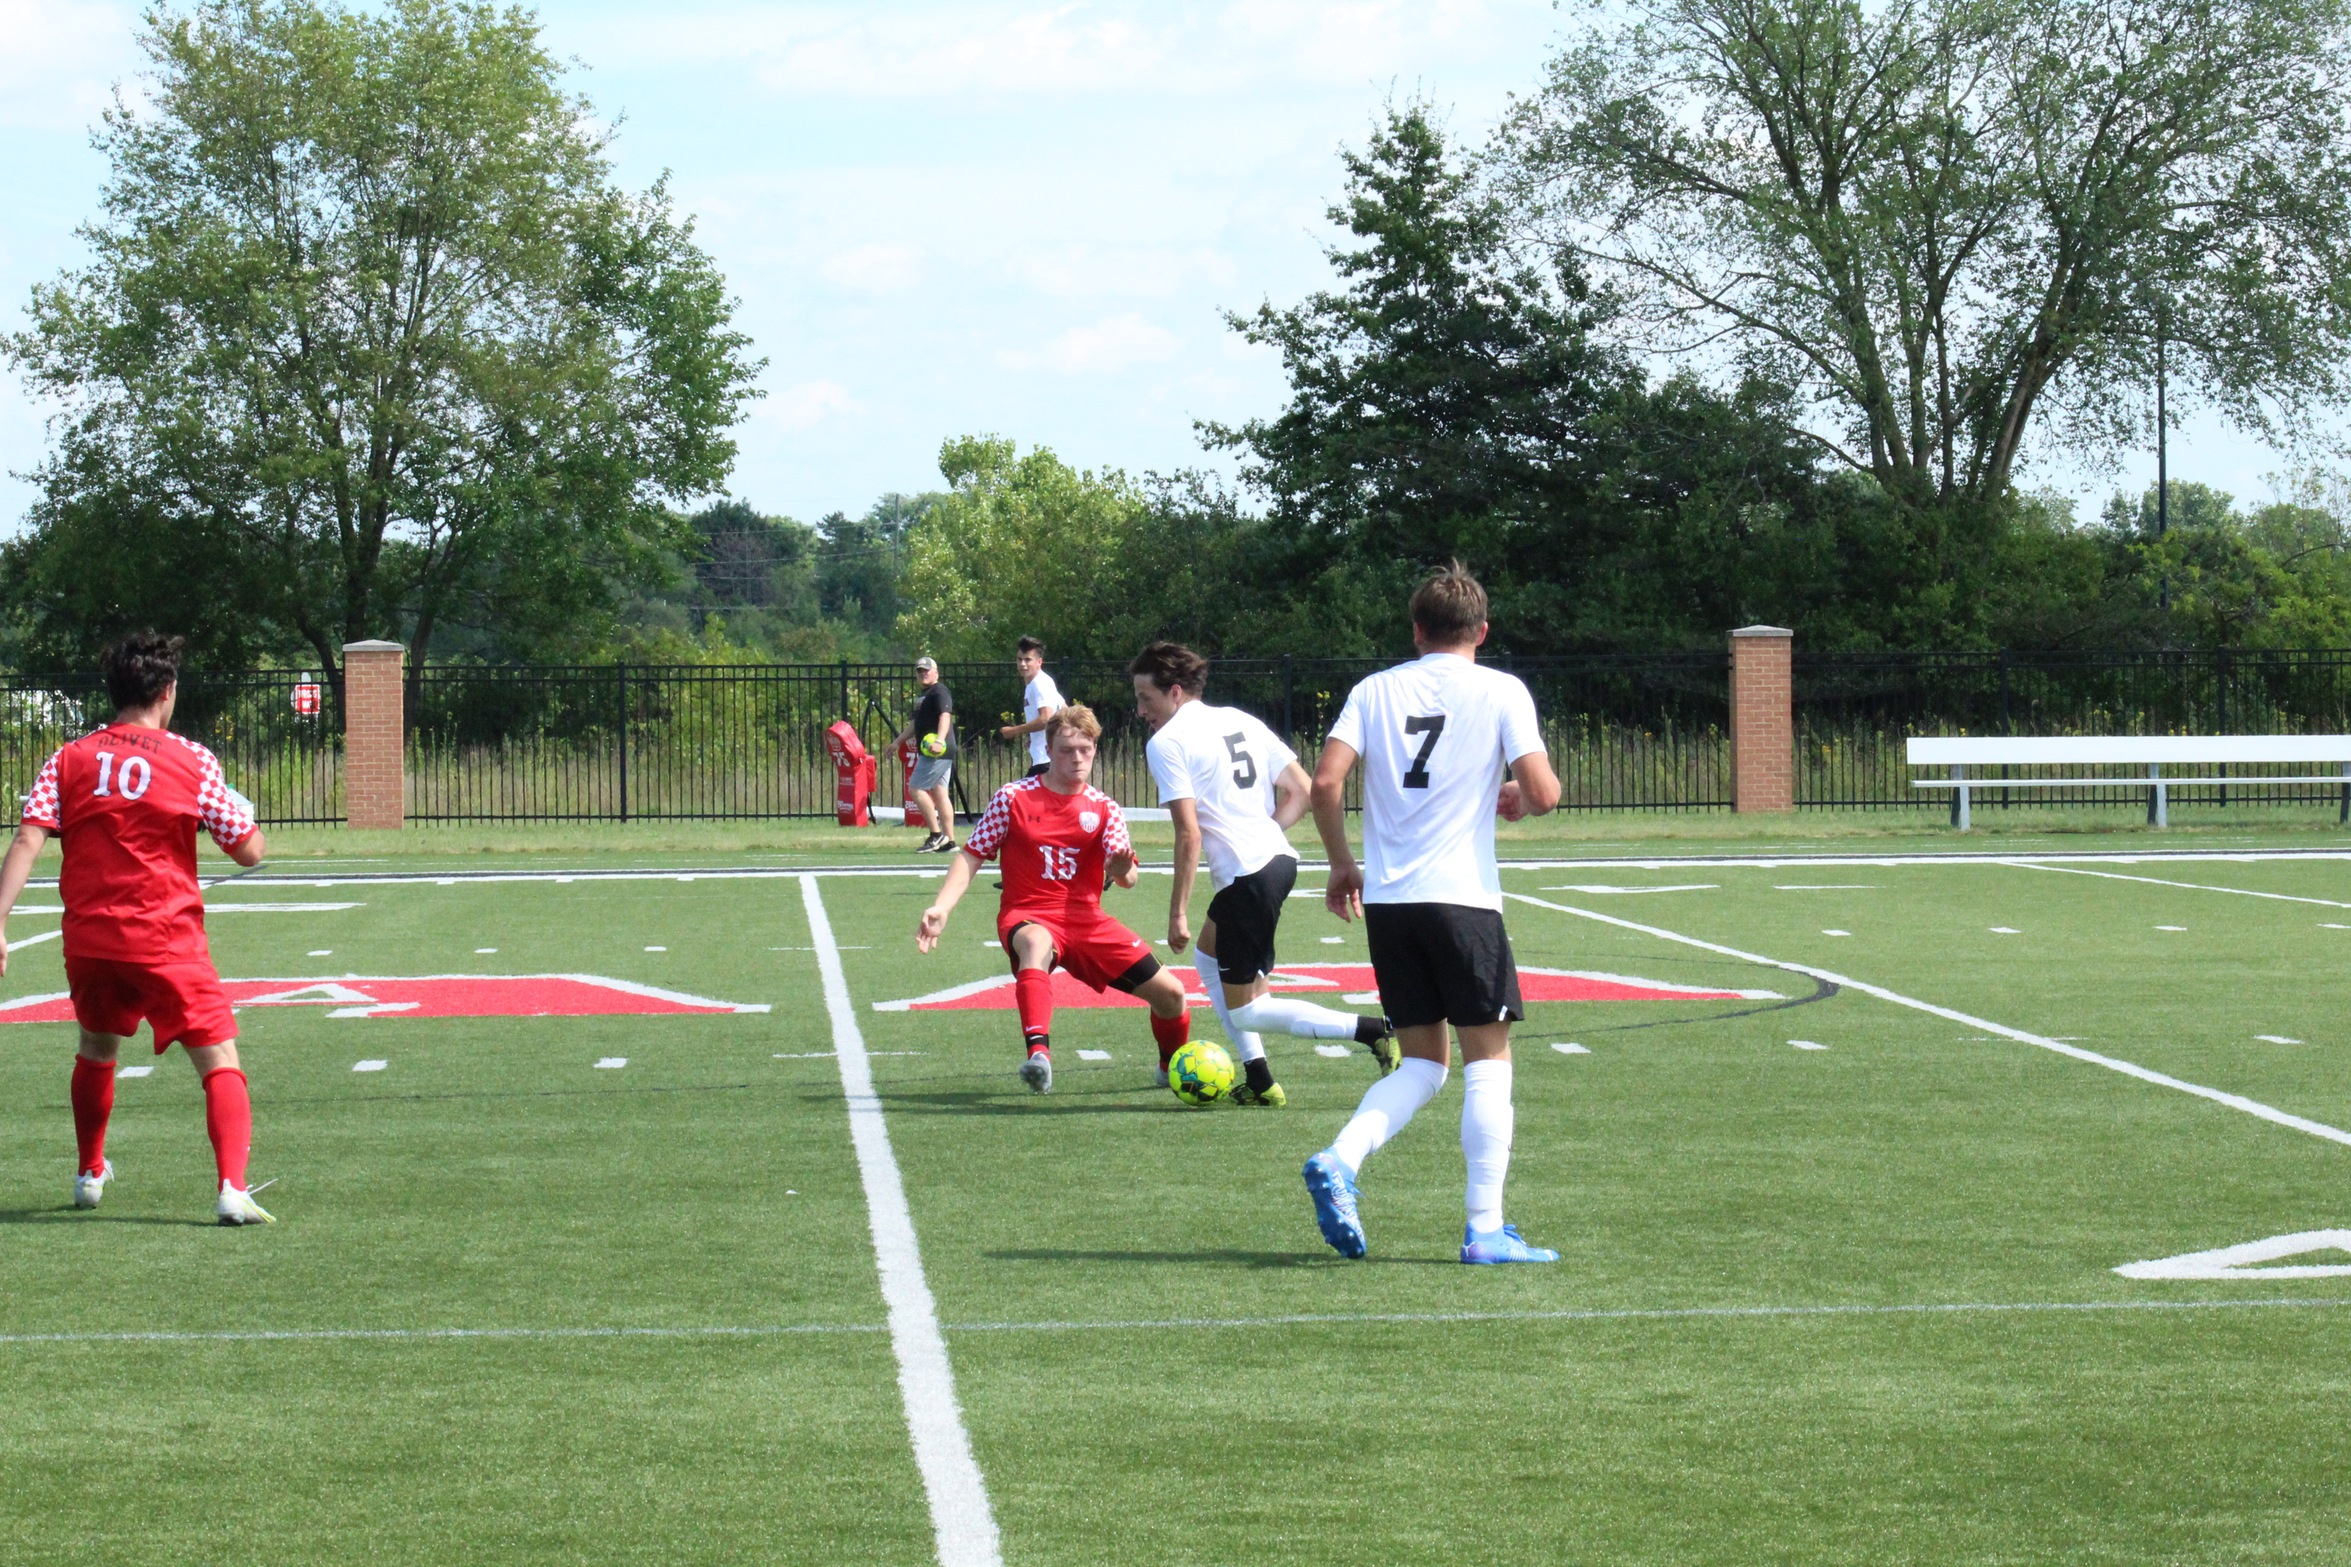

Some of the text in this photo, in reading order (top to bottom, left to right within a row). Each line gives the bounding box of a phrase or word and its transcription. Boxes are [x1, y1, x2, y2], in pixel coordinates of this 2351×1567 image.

[93, 751, 152, 801] 10
[1223, 731, 1257, 790] 5
[1402, 715, 1446, 789] 7
[1039, 845, 1080, 880] 15
